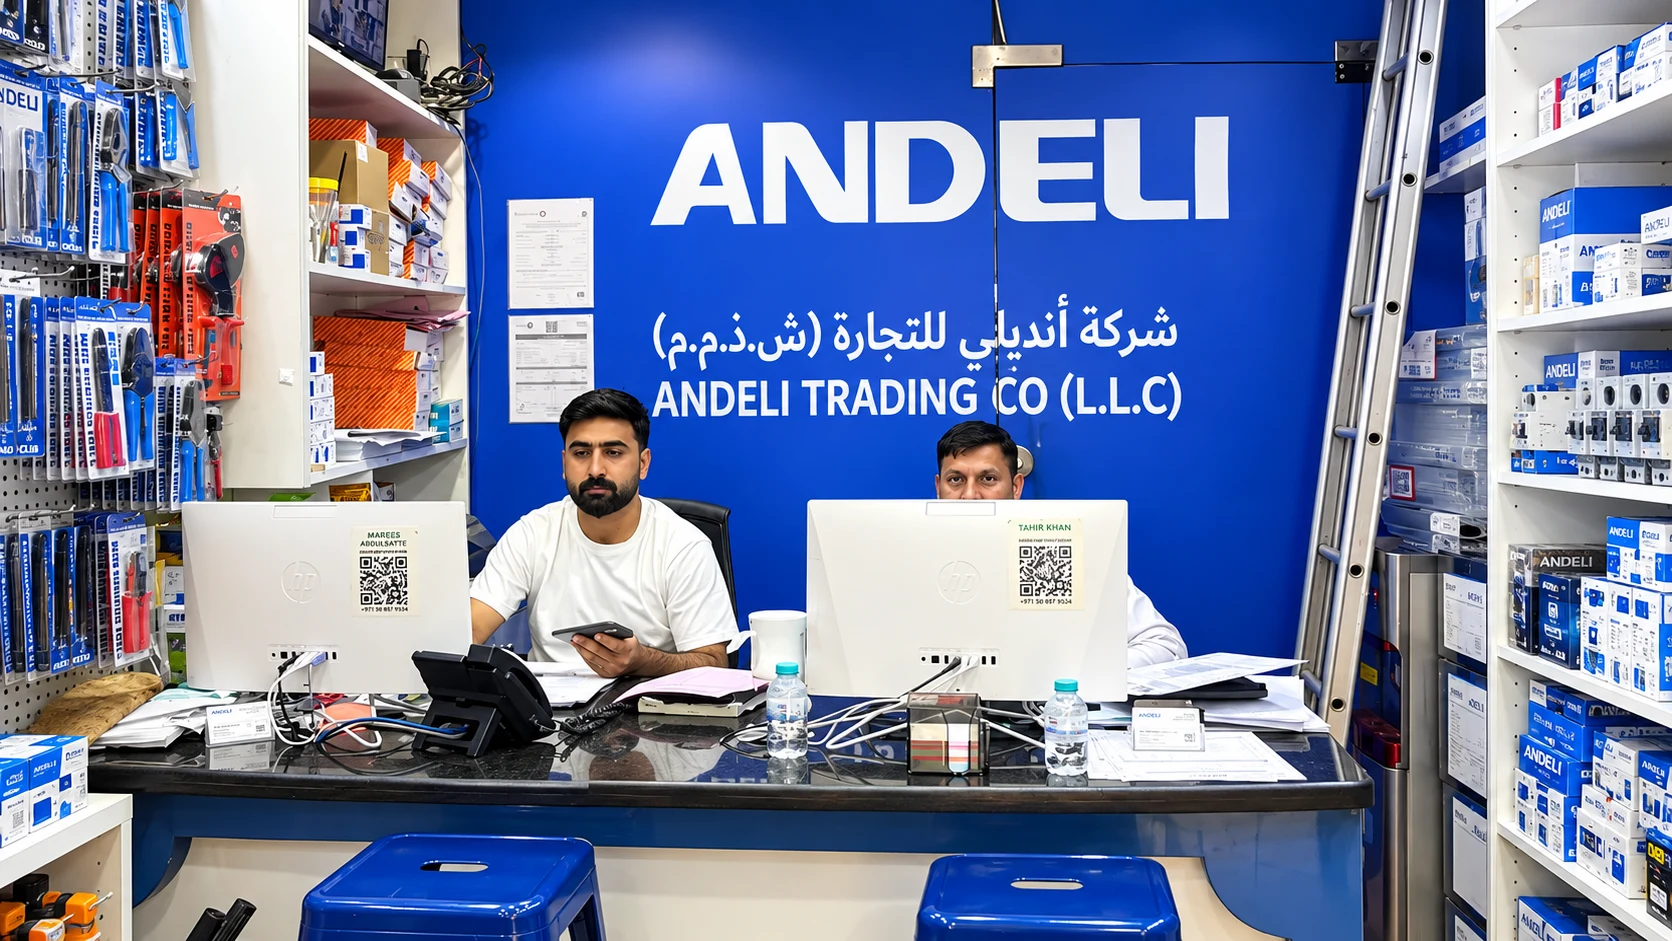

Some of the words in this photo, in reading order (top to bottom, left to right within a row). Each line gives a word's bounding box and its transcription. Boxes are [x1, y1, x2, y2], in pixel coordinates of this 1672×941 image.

[650, 116, 1230, 226] ANDELI
[834, 311, 946, 363] للتجارة
[958, 294, 1069, 373] أنديلي
[1080, 306, 1178, 358] شركة
[1545, 363, 1576, 379] ANDELI
[652, 381, 789, 417] ANDELI
[801, 378, 979, 416] TRADING
[992, 376, 1048, 416] CO
[1060, 372, 1182, 422] (L.L.C)
[1609, 526, 1634, 539] ANDELI
[1540, 556, 1593, 568] ANDELI
[1524, 745, 1562, 777] ANDELI
